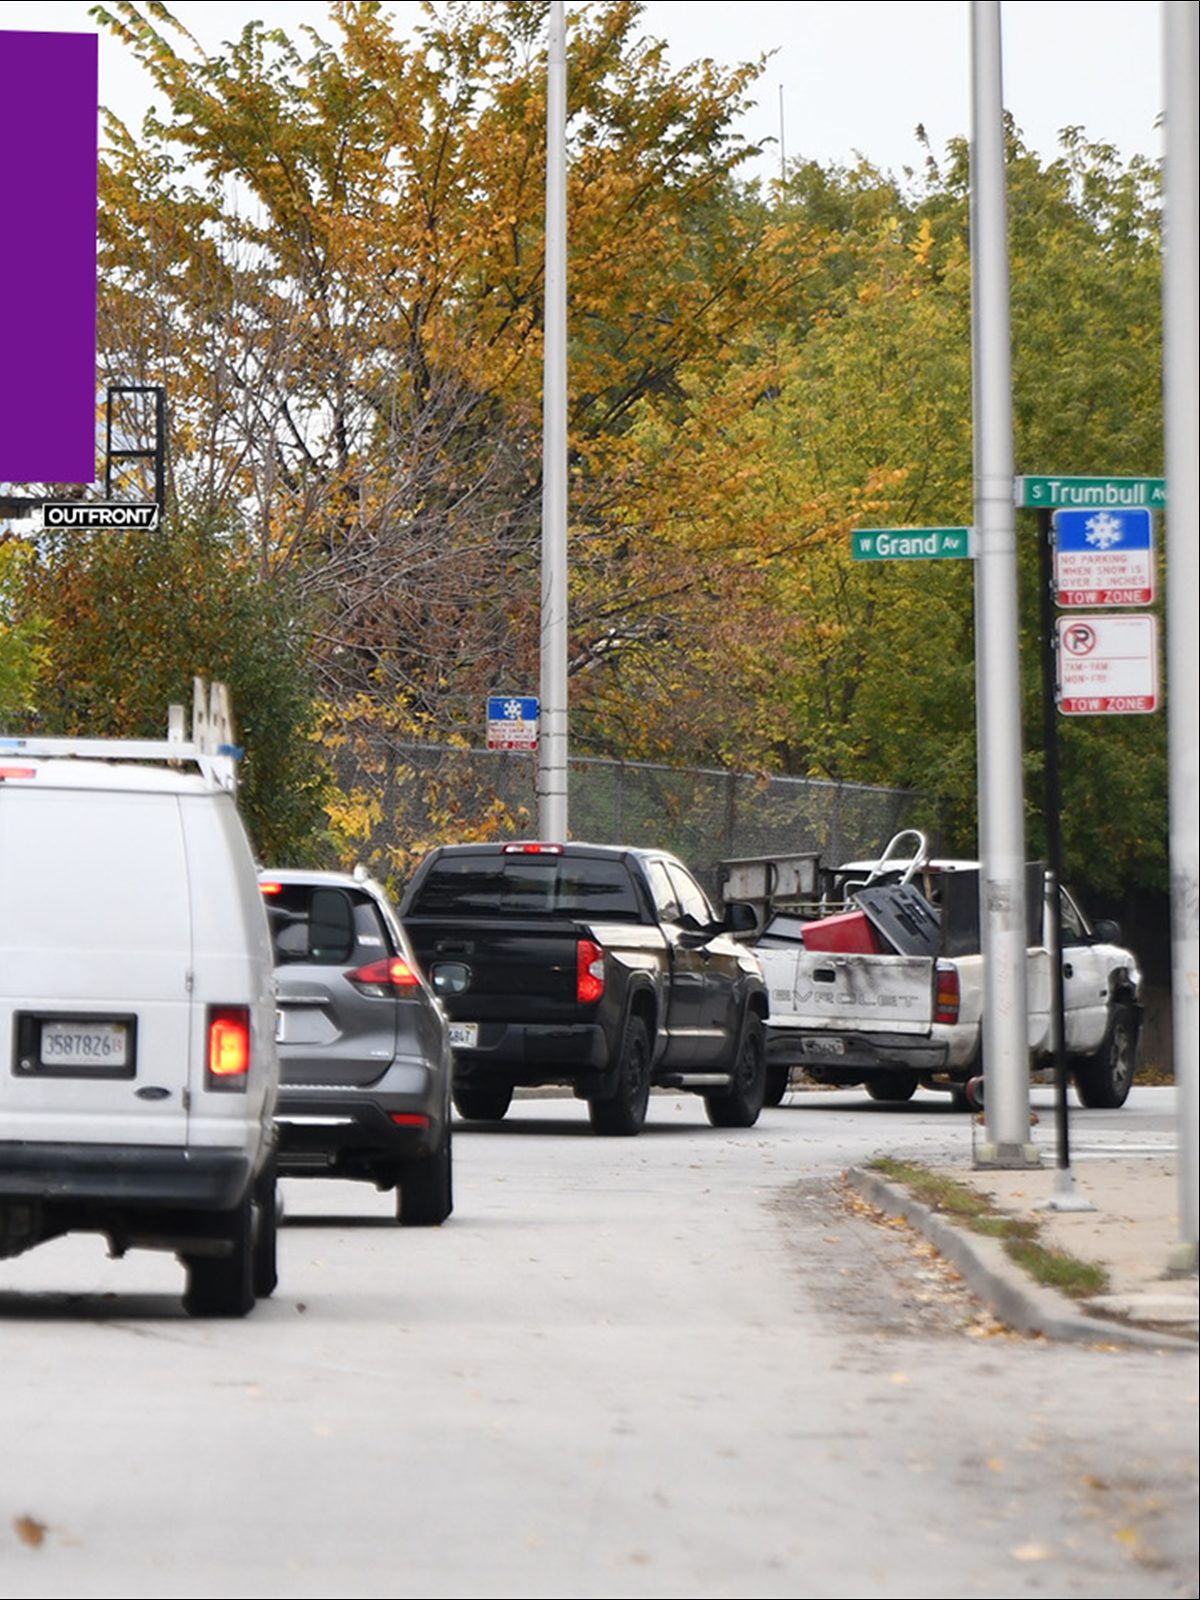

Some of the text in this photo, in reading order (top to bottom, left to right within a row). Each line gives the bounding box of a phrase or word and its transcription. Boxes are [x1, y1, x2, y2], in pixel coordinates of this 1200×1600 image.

[1032, 485, 1041, 499] S
[1047, 482, 1145, 504] Trumbull
[48, 508, 152, 524] OUTFRONT
[859, 533, 959, 556] W Grand Av
[1061, 554, 1128, 565] NO PARKING
[1062, 567, 1091, 576] WHEN
[1096, 565, 1127, 575] SNOW
[1062, 578, 1090, 588] OVER
[1107, 576, 1145, 586] INCHES
[1066, 590, 1142, 605] TOW ZONE
[1069, 698, 1145, 713] TOW ZONE
